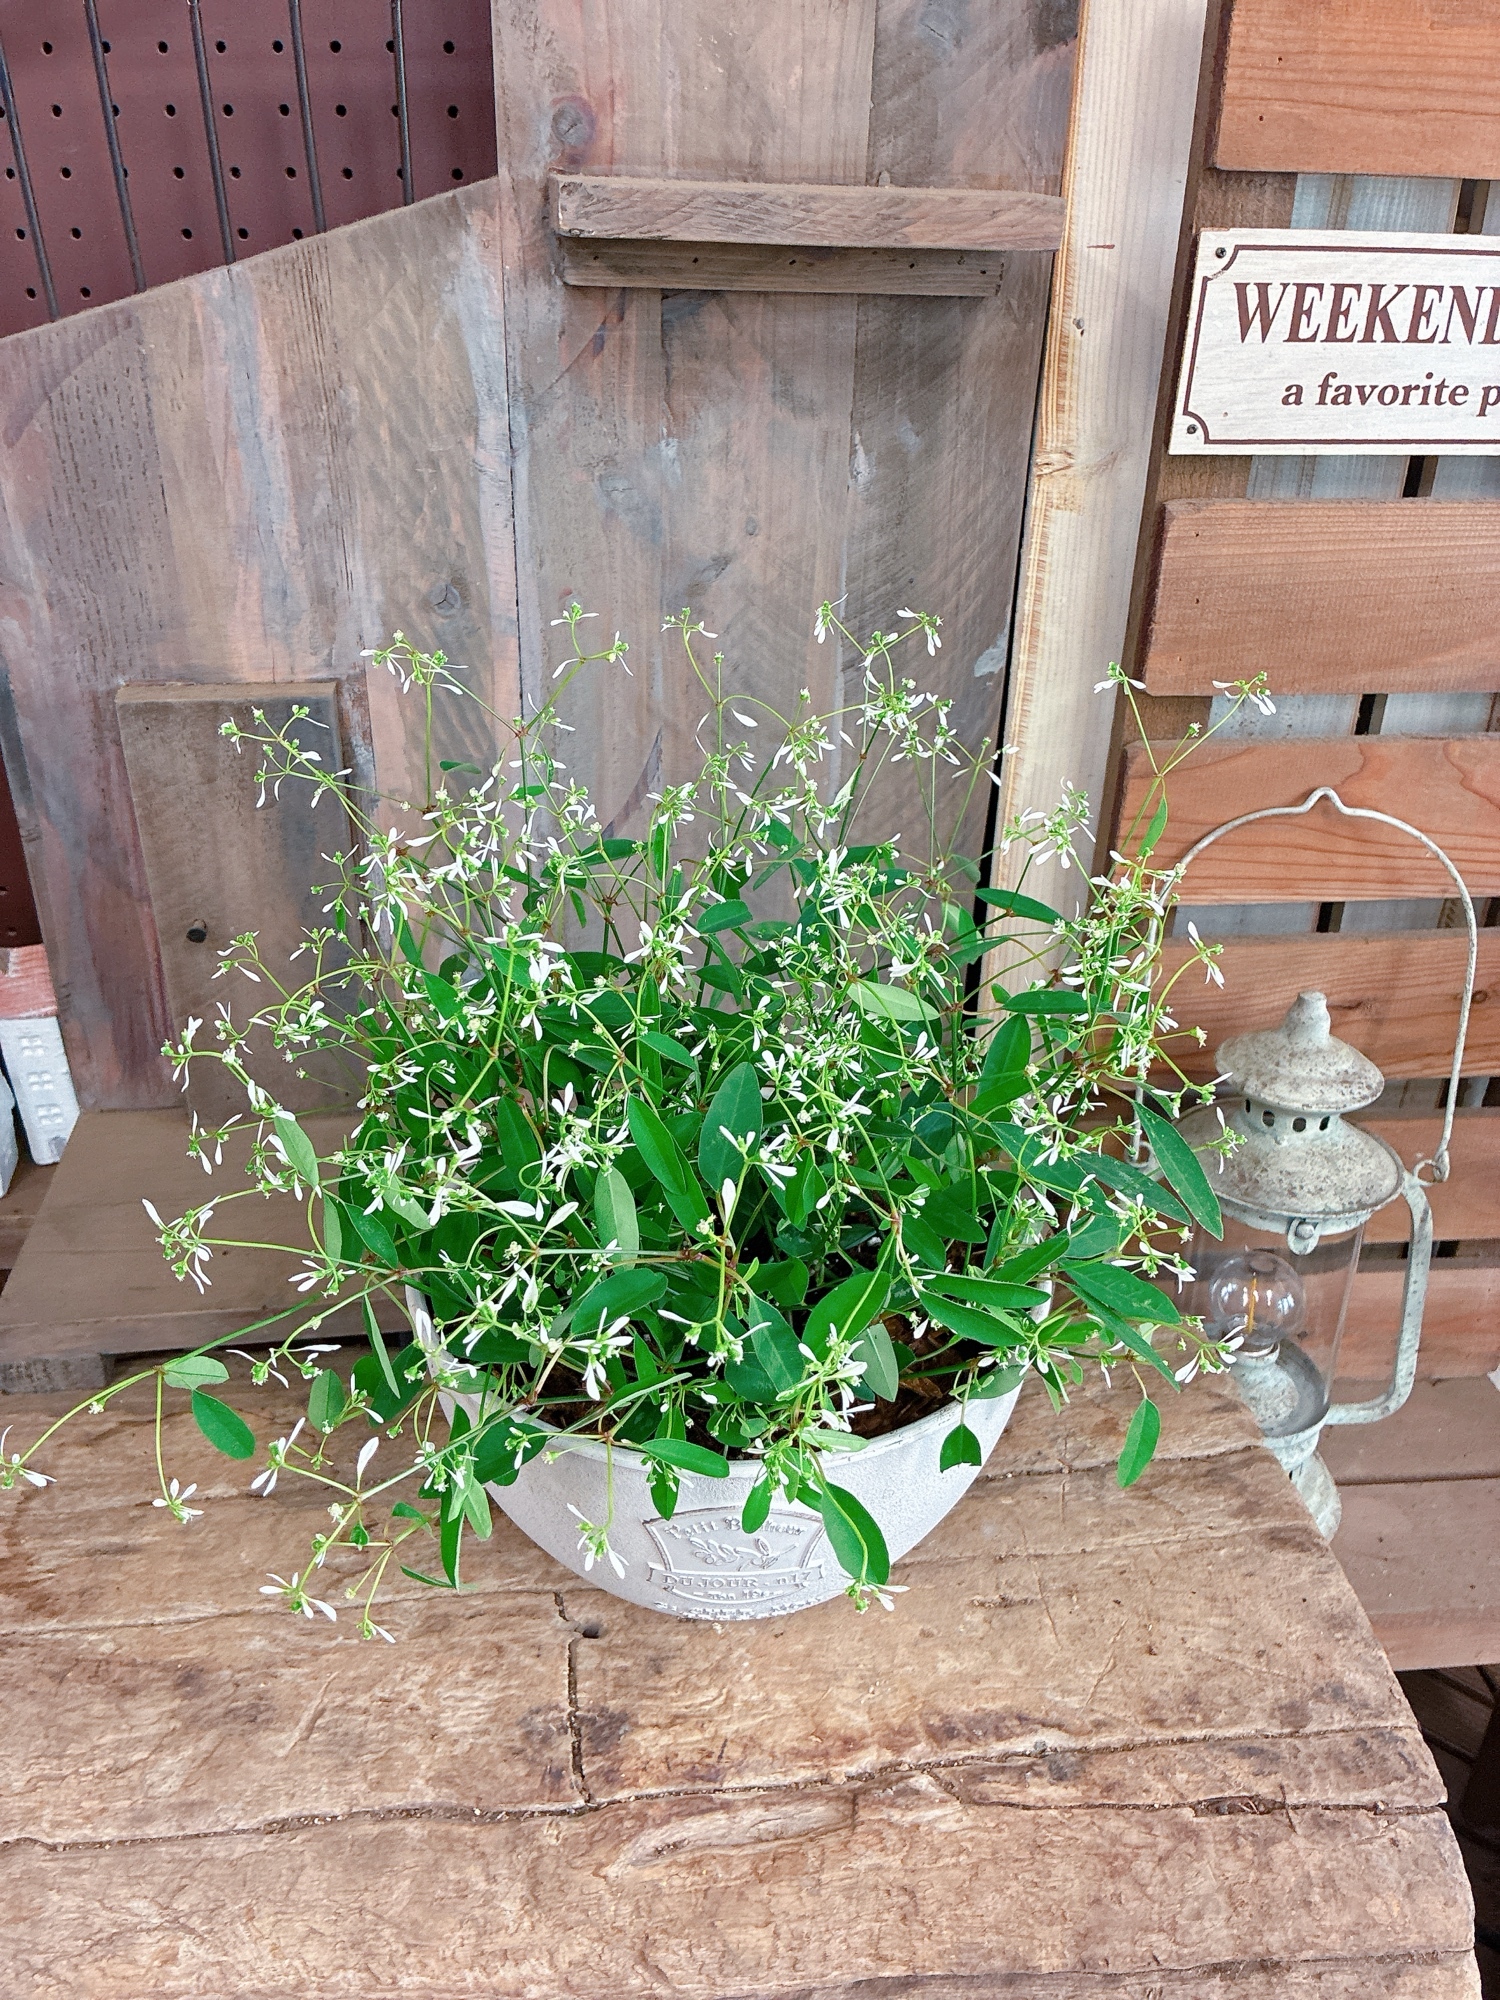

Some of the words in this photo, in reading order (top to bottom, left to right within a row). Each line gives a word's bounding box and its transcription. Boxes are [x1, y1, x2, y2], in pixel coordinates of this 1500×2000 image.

[1281, 384, 1303, 406] a
[1315, 372, 1469, 407] favorite
[662, 1573, 695, 1587] DU
[697, 1577, 759, 1589] JOUR
